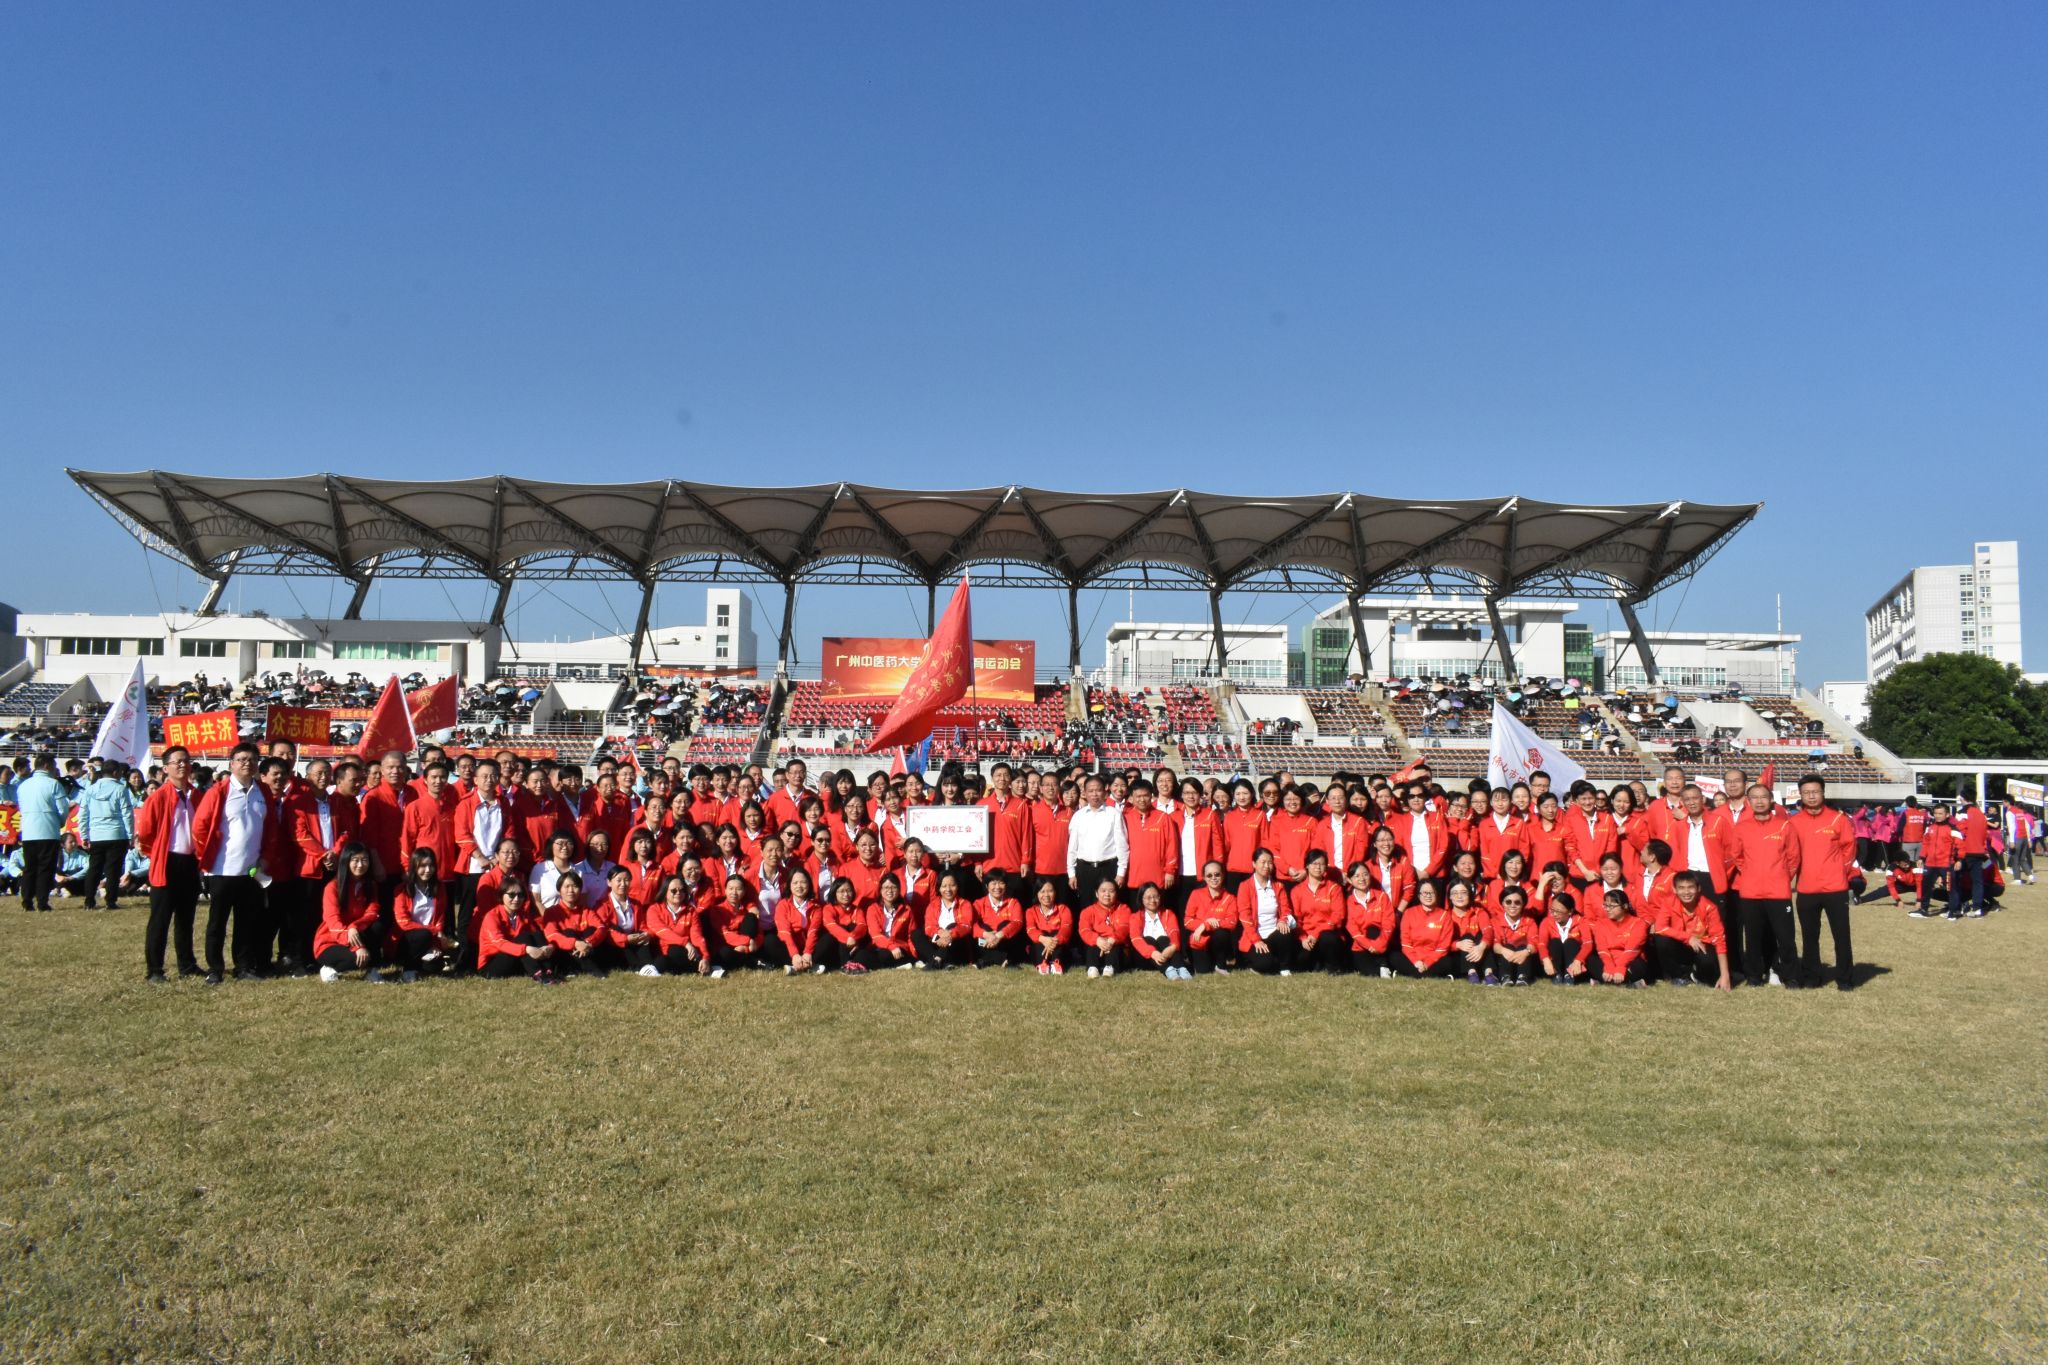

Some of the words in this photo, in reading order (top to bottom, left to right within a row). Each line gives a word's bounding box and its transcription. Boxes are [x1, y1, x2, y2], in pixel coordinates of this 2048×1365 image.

[169, 716, 233, 747] 同舟共济
[271, 711, 328, 740] 众志成城
[923, 825, 973, 834] 中药学院工会
